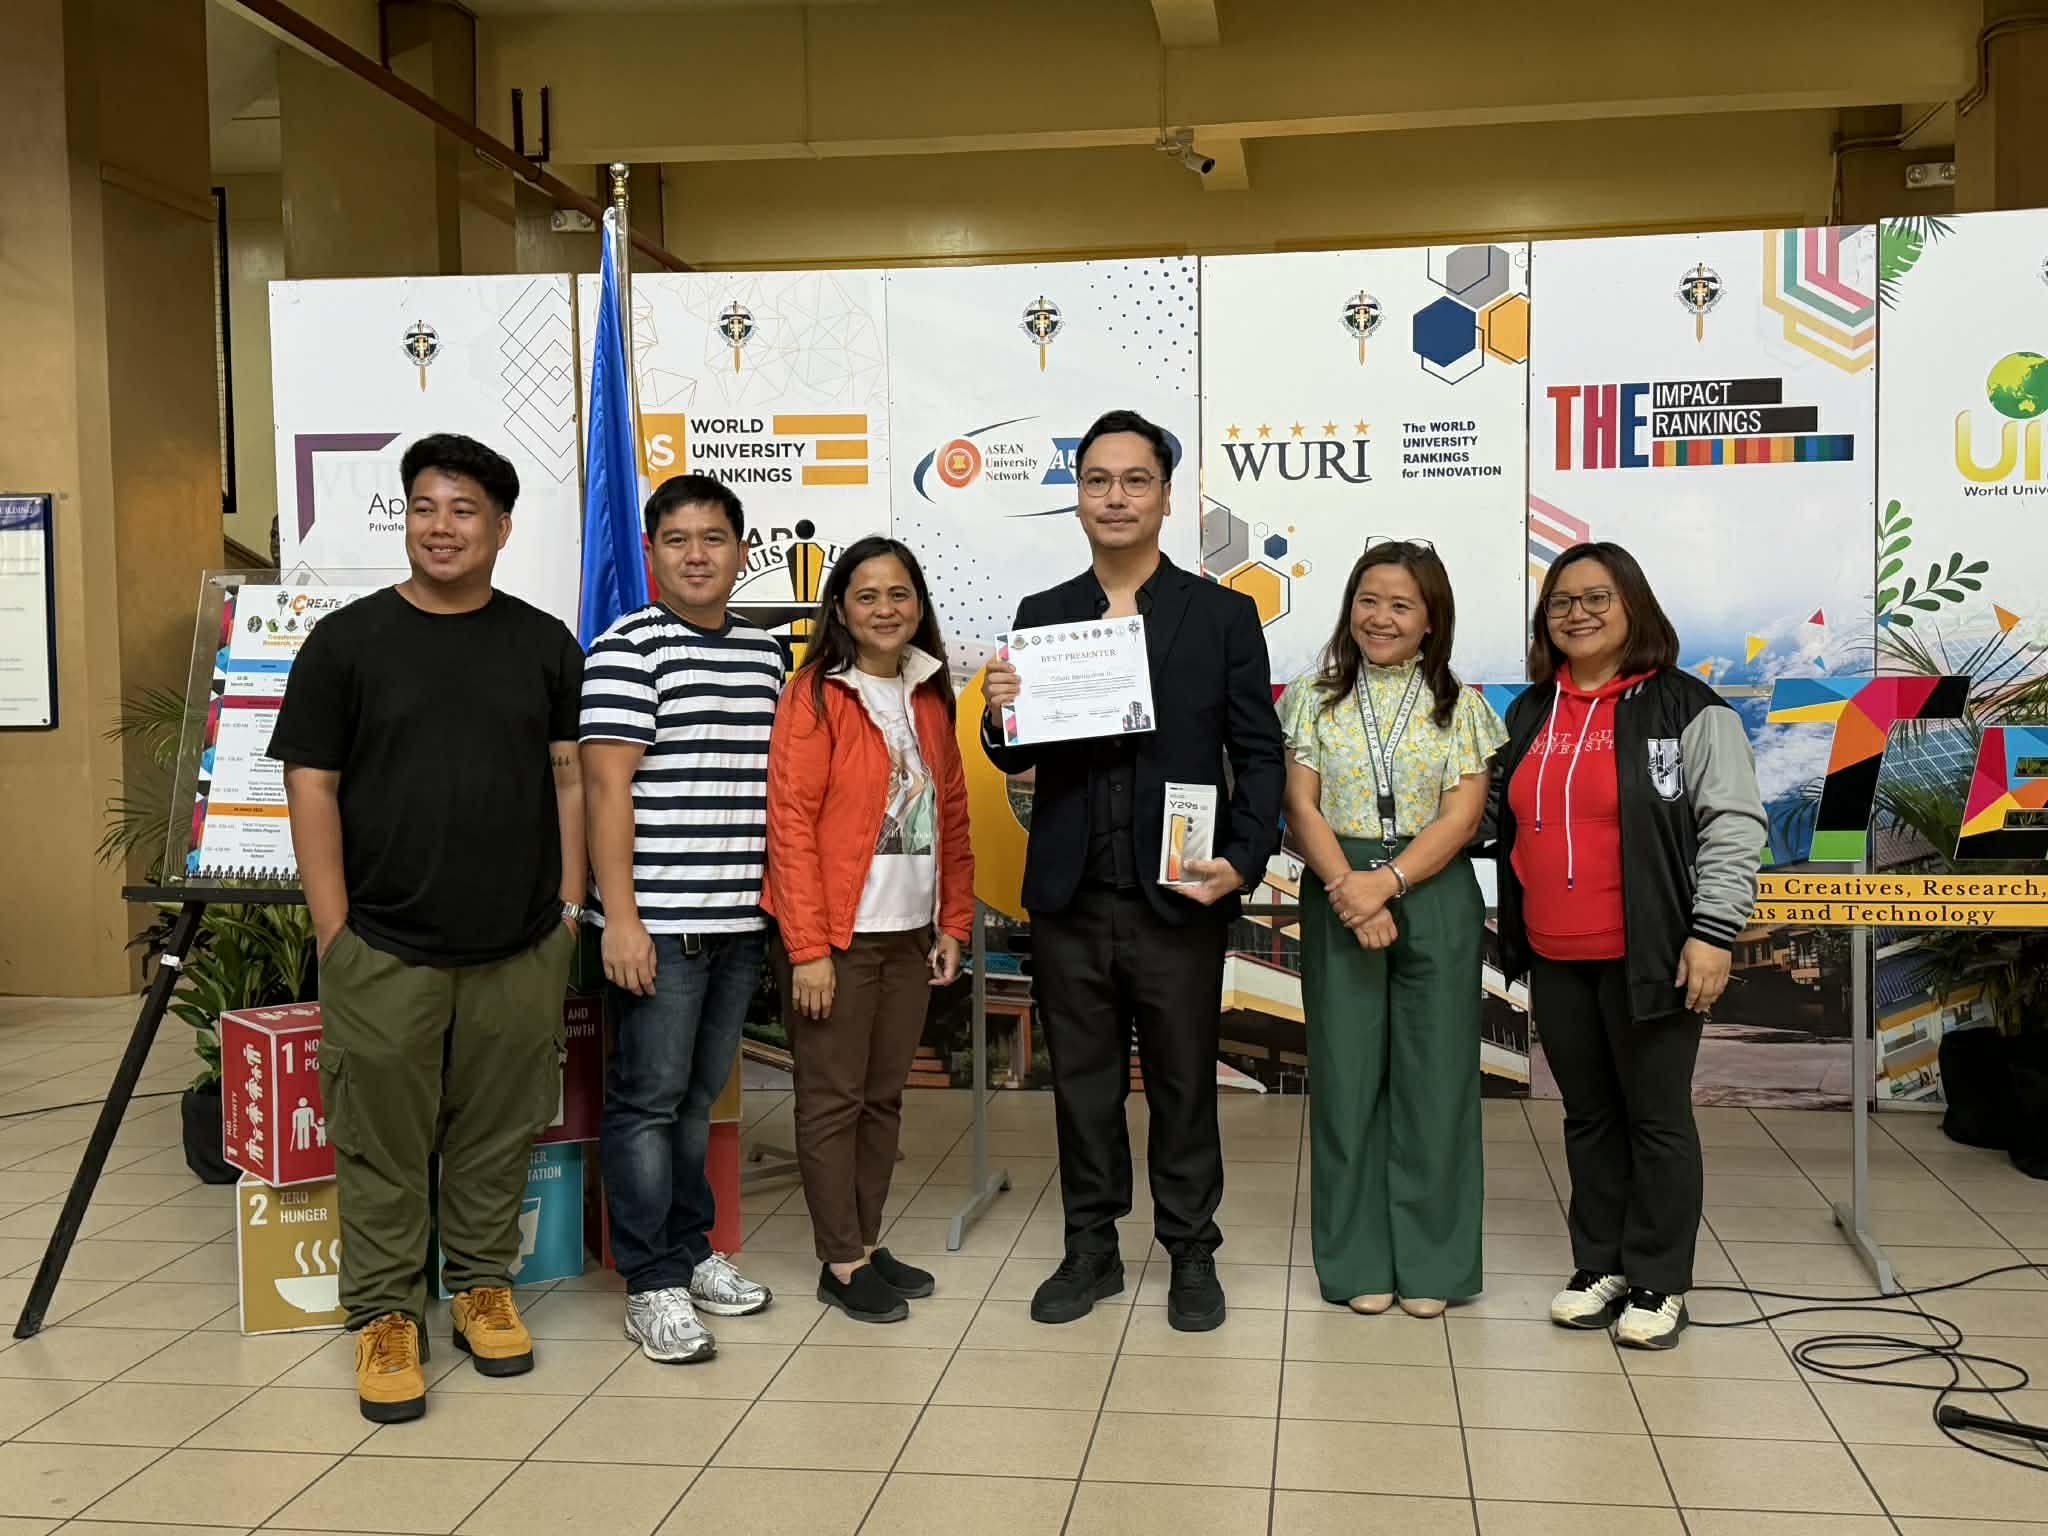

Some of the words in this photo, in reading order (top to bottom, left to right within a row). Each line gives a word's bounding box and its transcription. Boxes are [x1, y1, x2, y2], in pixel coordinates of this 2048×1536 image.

[1655, 382, 1732, 406] IMPACT
[691, 419, 764, 434] WORLD
[1403, 423, 1426, 434] The
[1430, 421, 1476, 433] WORLD
[1547, 383, 1649, 471] THE
[1655, 410, 1762, 435] RANKINGS
[985, 444, 1024, 455] ASEAN
[1403, 436, 1478, 448] UNIVERSITY
[646, 434, 676, 471] S
[692, 443, 806, 458] UNIVERSITY
[1403, 452, 1469, 464] RANKINGS
[985, 457, 1039, 469] University
[1221, 440, 1373, 484] WURI
[985, 471, 1031, 481] Network
[1402, 468, 1421, 479] for
[1423, 466, 1502, 478] INNOVATION
[1964, 485, 2008, 497] World
[2013, 485, 2048, 496] Univ
[369, 522, 405, 533] Private
[1785, 879, 1912, 898] Creatives,
[1923, 880, 2048, 898] Research,
[1786, 904, 1832, 920] and
[1843, 905, 1996, 925] Technology
[282, 1042, 294, 1074] 1
[249, 1193, 268, 1226] 2
[279, 1192, 309, 1206] ZERO
[280, 1207, 328, 1224] HUNGER
